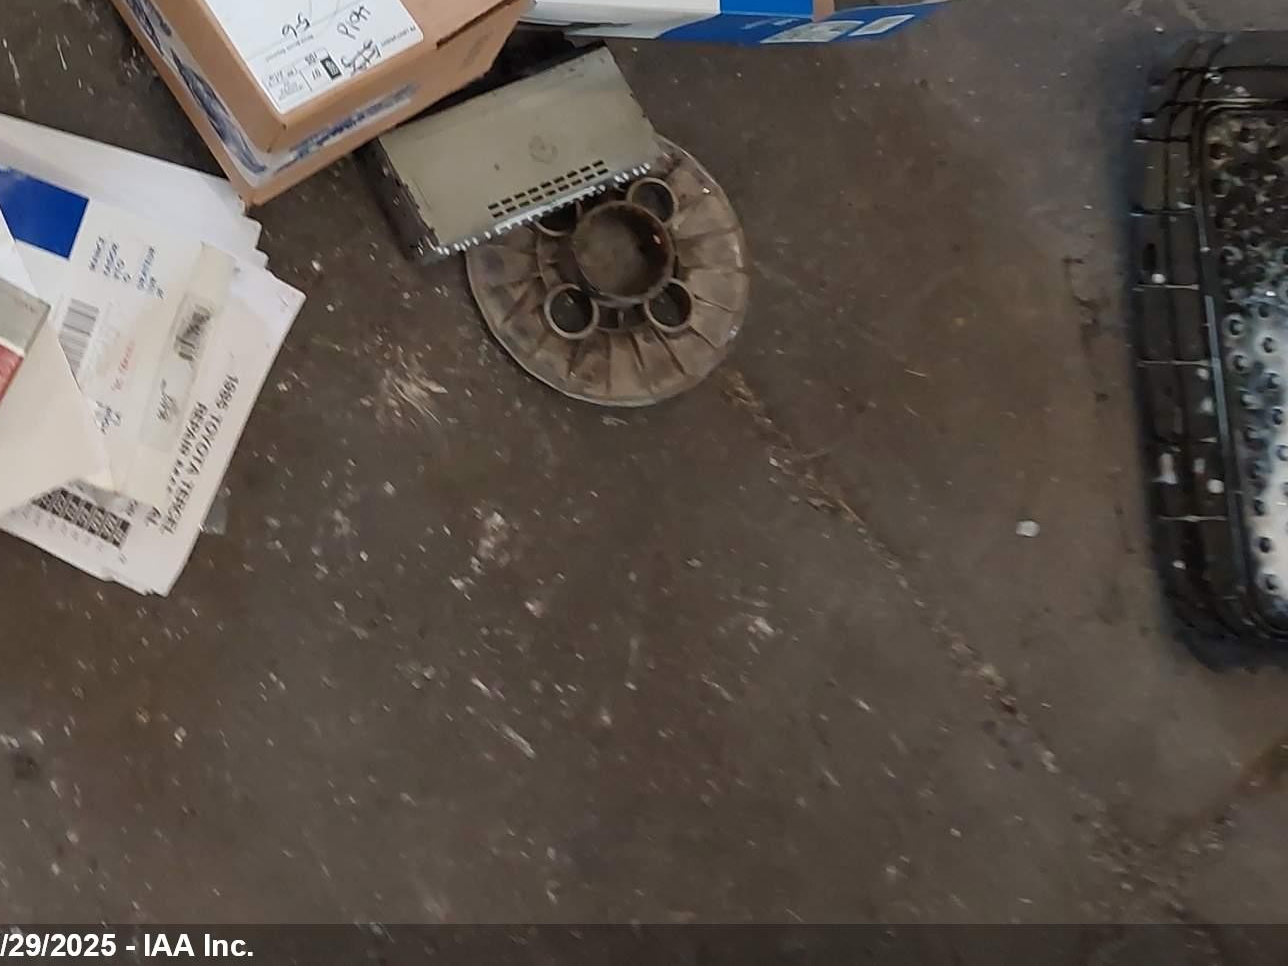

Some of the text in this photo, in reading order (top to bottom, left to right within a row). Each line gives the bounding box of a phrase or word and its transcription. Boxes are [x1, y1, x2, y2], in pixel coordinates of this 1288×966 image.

[175, 402, 210, 456] REPAIR
[184, 412, 225, 477] TOYOTA
[159, 477, 197, 536] TERCEL
